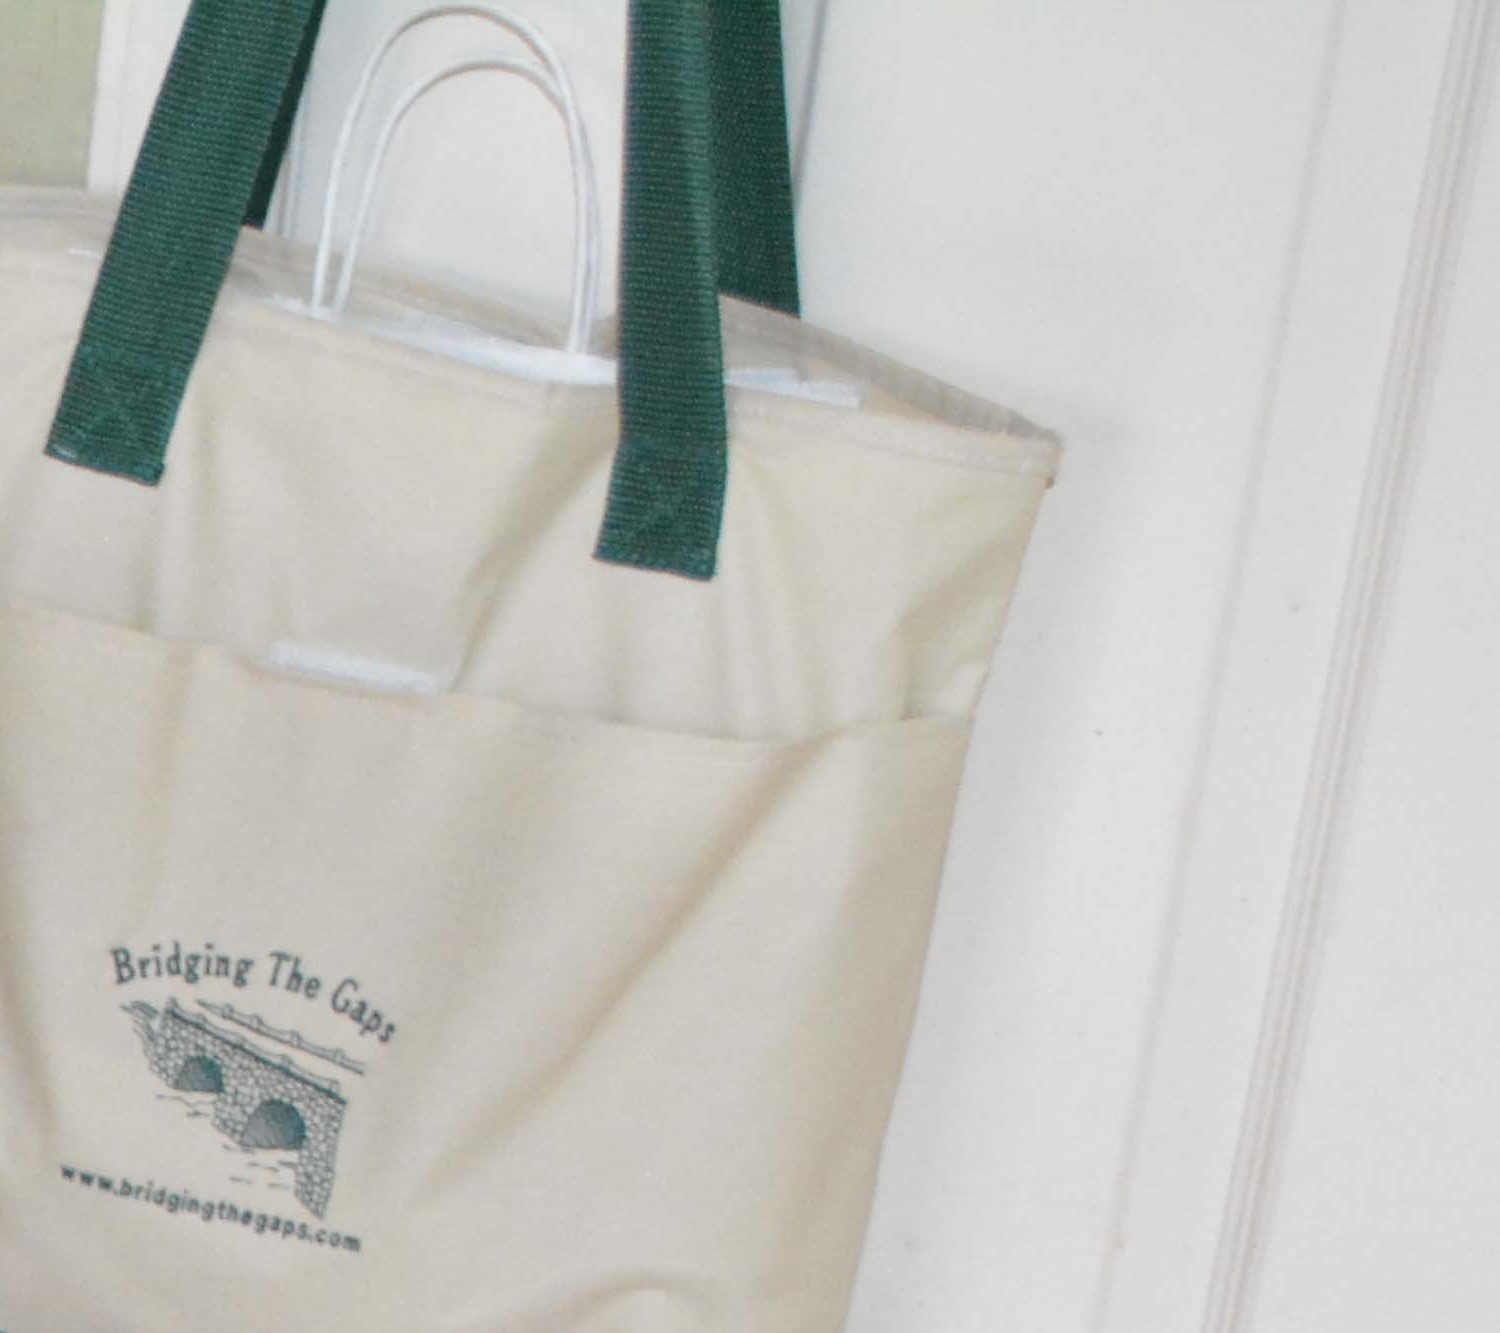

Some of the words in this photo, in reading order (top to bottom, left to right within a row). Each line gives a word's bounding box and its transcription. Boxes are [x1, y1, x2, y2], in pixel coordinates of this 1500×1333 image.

[110, 940, 253, 988] Bridging
[269, 950, 321, 999] The
[330, 977, 396, 1044] Gaps
[59, 1163, 362, 1253] www.bridgingthegaps.com
